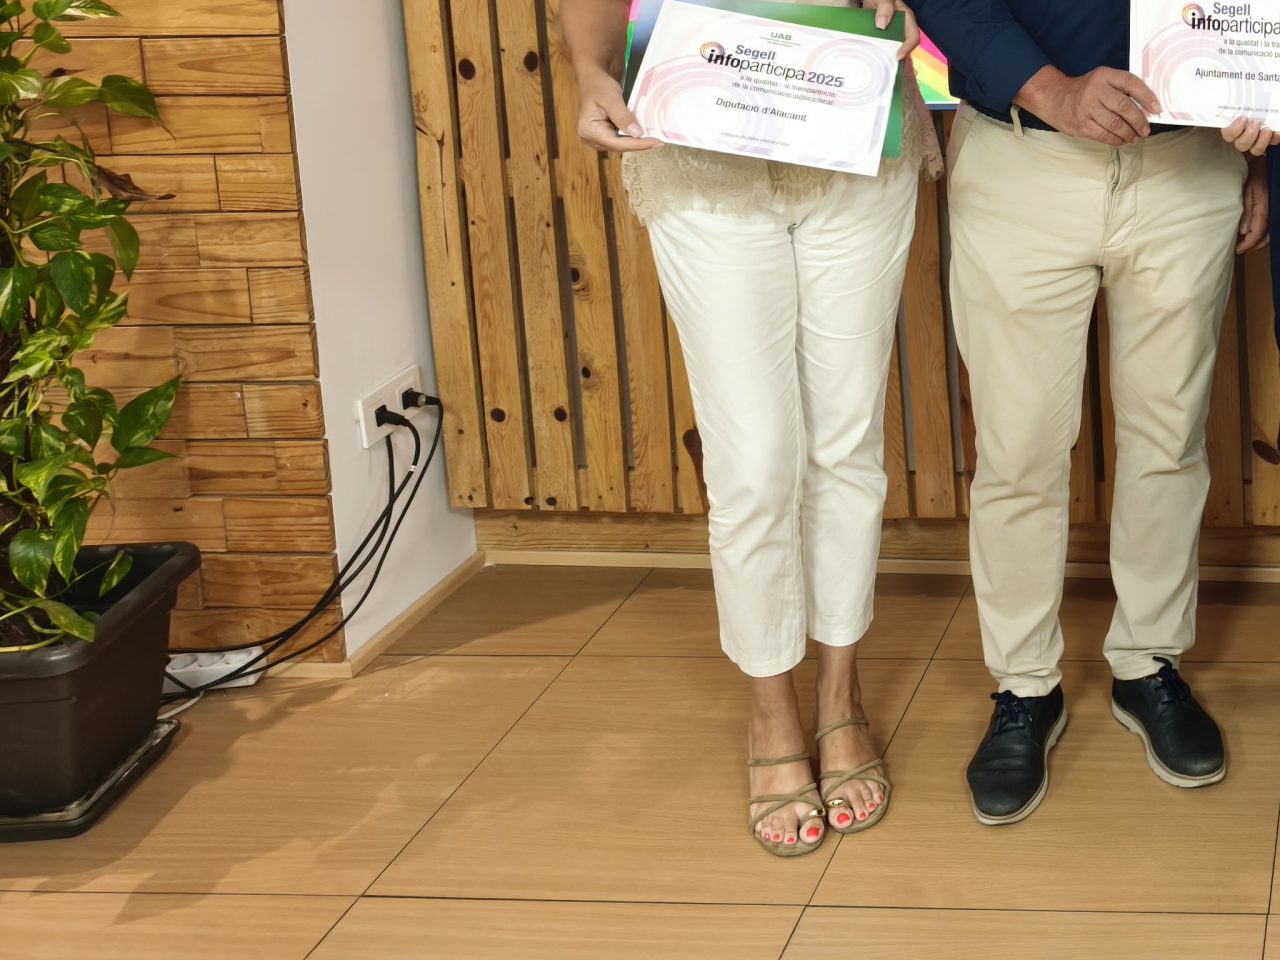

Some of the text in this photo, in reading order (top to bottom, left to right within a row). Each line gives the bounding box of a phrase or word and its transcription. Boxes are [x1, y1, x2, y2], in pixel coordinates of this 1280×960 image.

[1213, 1, 1251, 18] Segell
[735, 44, 777, 61] Segell
[807, 71, 846, 88] 2025
[1195, 67, 1243, 79] Ajuntament
[1245, 71, 1256, 81] de
